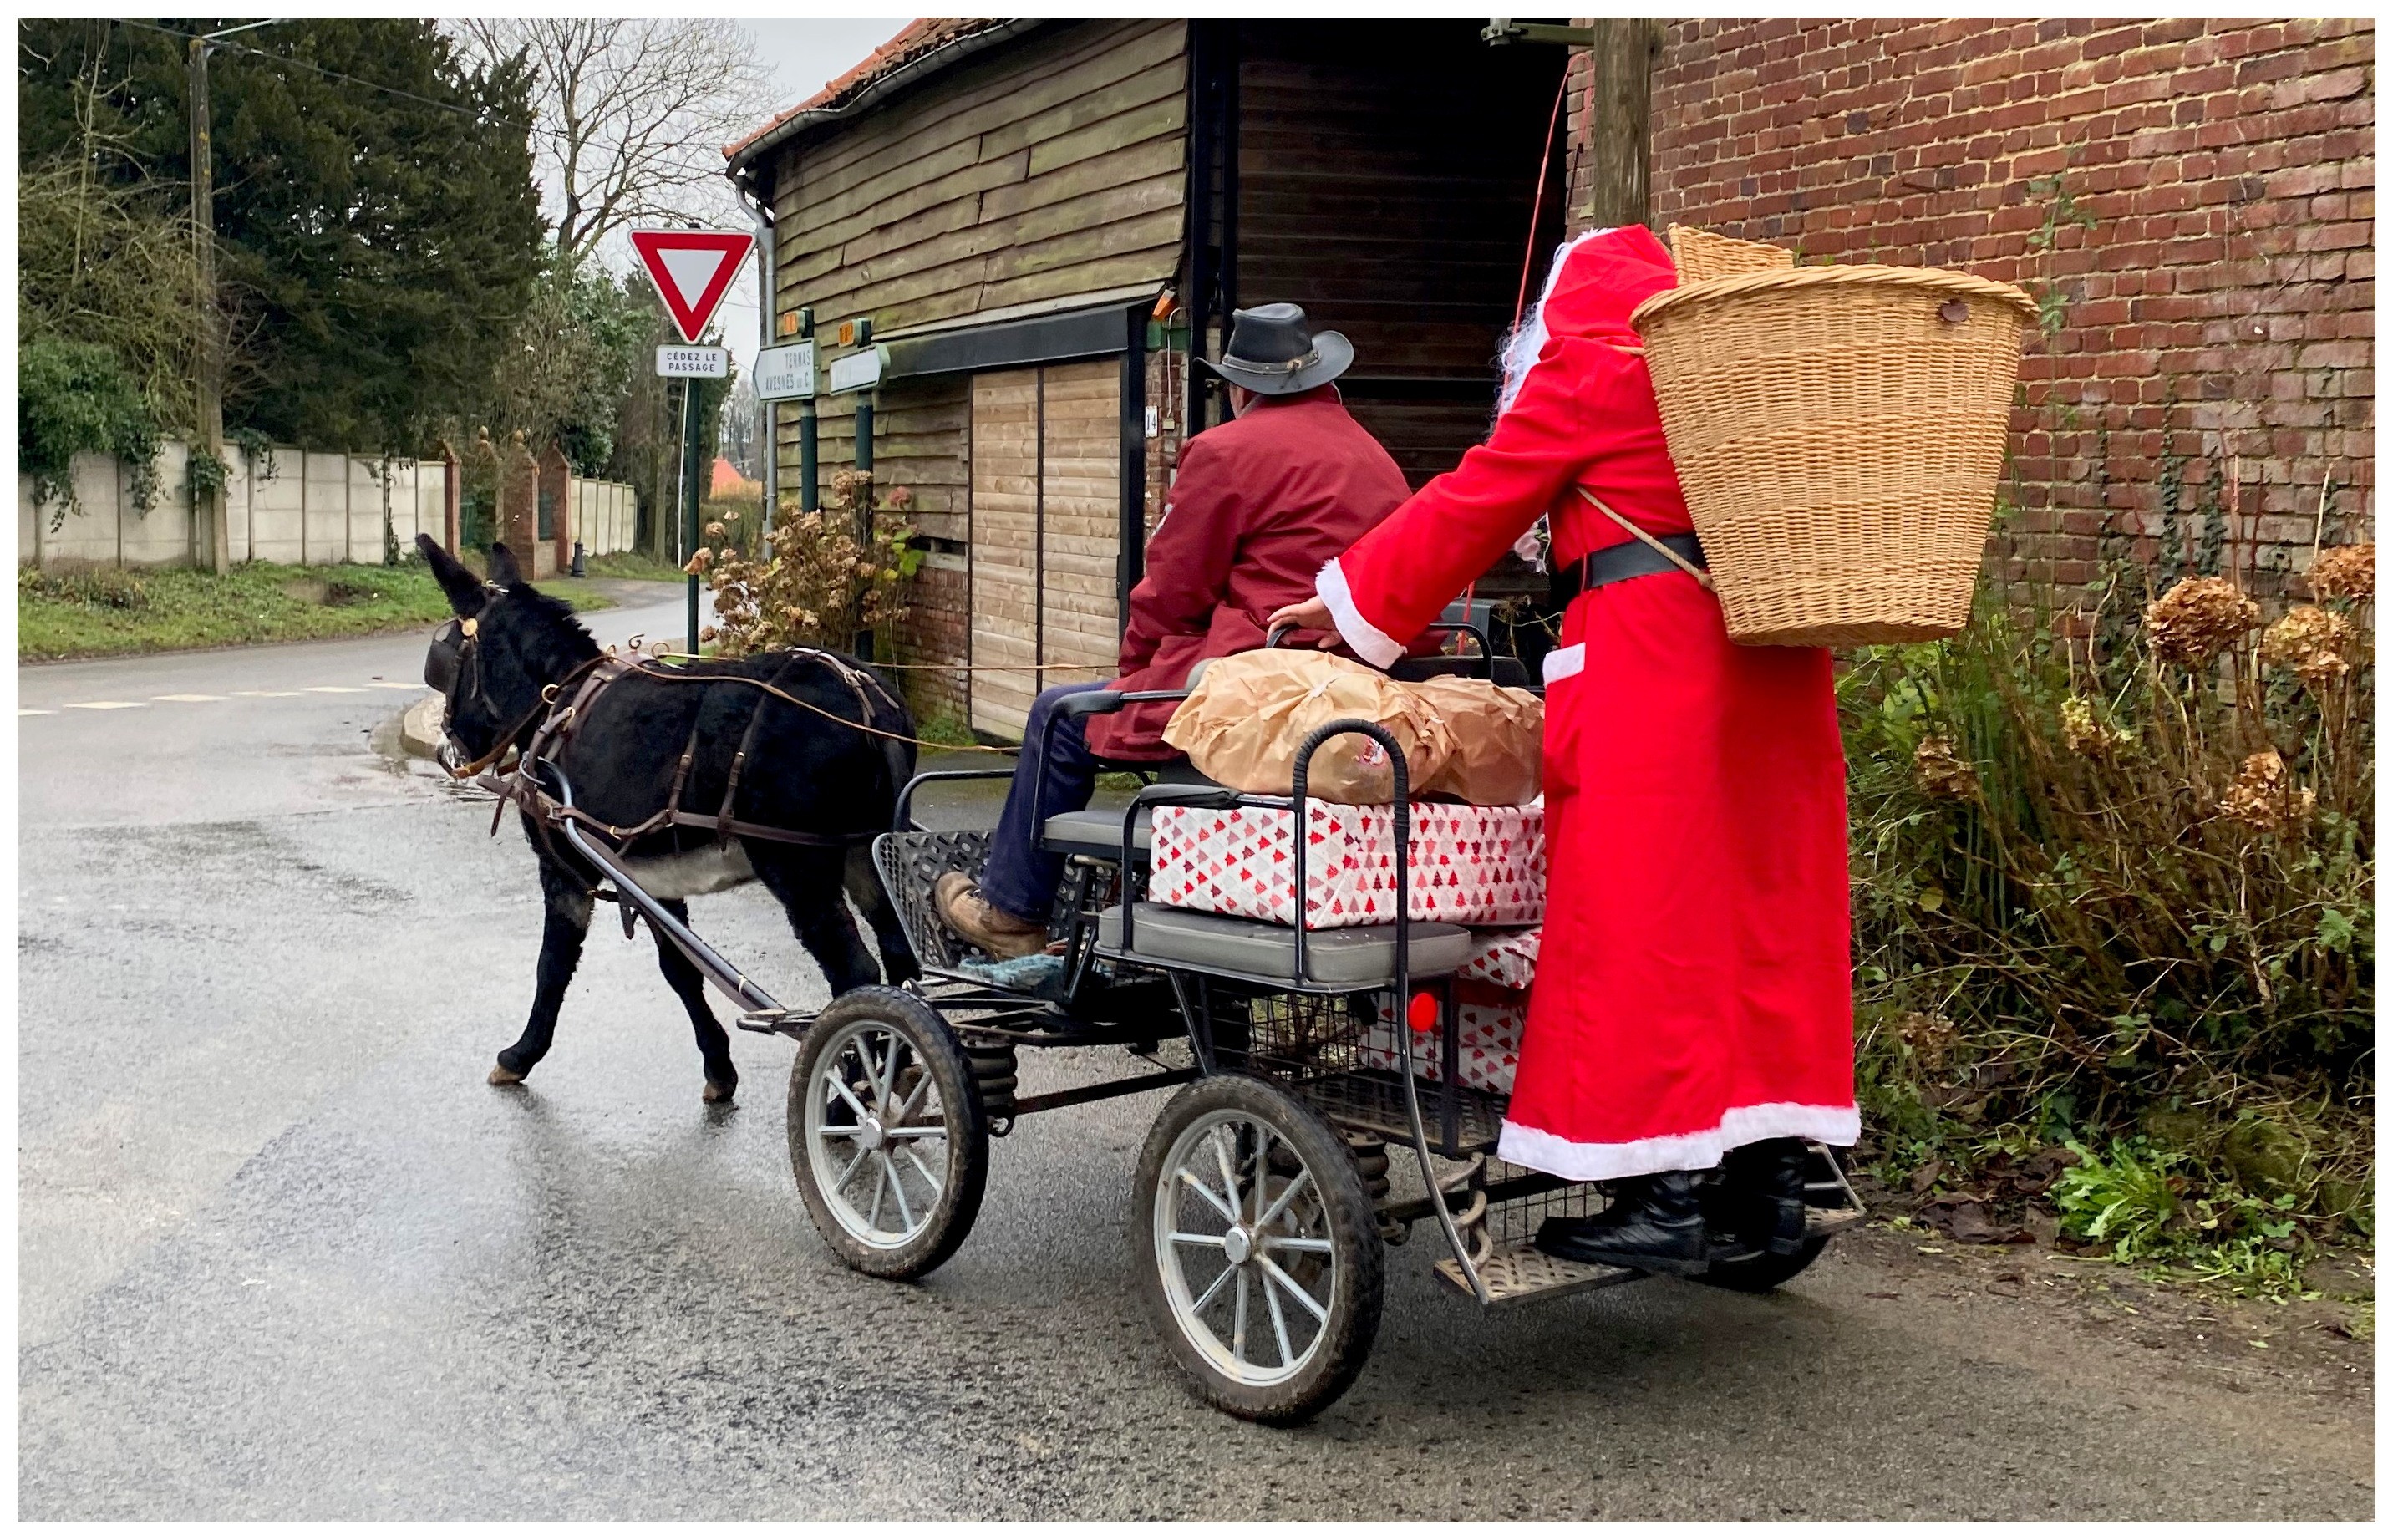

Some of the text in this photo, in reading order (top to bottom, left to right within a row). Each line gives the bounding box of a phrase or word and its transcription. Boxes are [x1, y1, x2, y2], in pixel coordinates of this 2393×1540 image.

[667, 351, 700, 361] CÉDEZ
[668, 363, 715, 372] PASSAGE
[1146, 413, 1156, 430] 14
